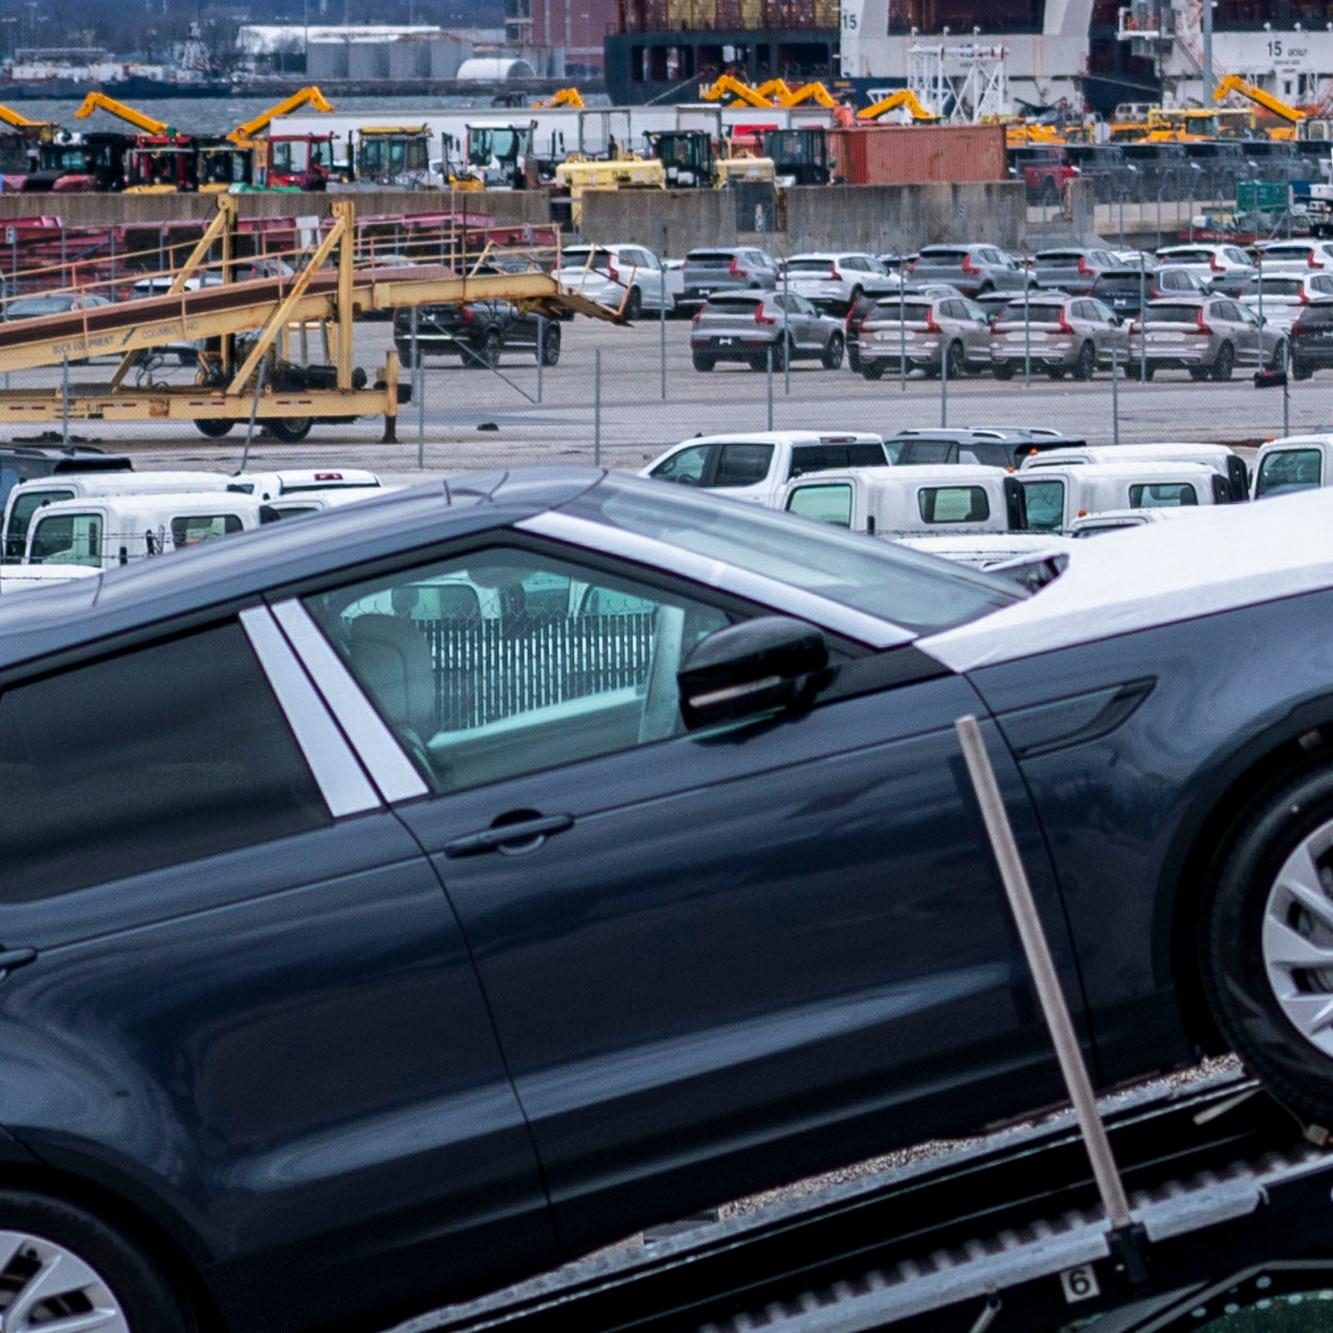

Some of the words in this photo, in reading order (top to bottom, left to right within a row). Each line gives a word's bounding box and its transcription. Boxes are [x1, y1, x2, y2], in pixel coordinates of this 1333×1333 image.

[843, 15, 857, 29] 15
[1268, 41, 1282, 56] 15
[1068, 1270, 1090, 1295] 6
